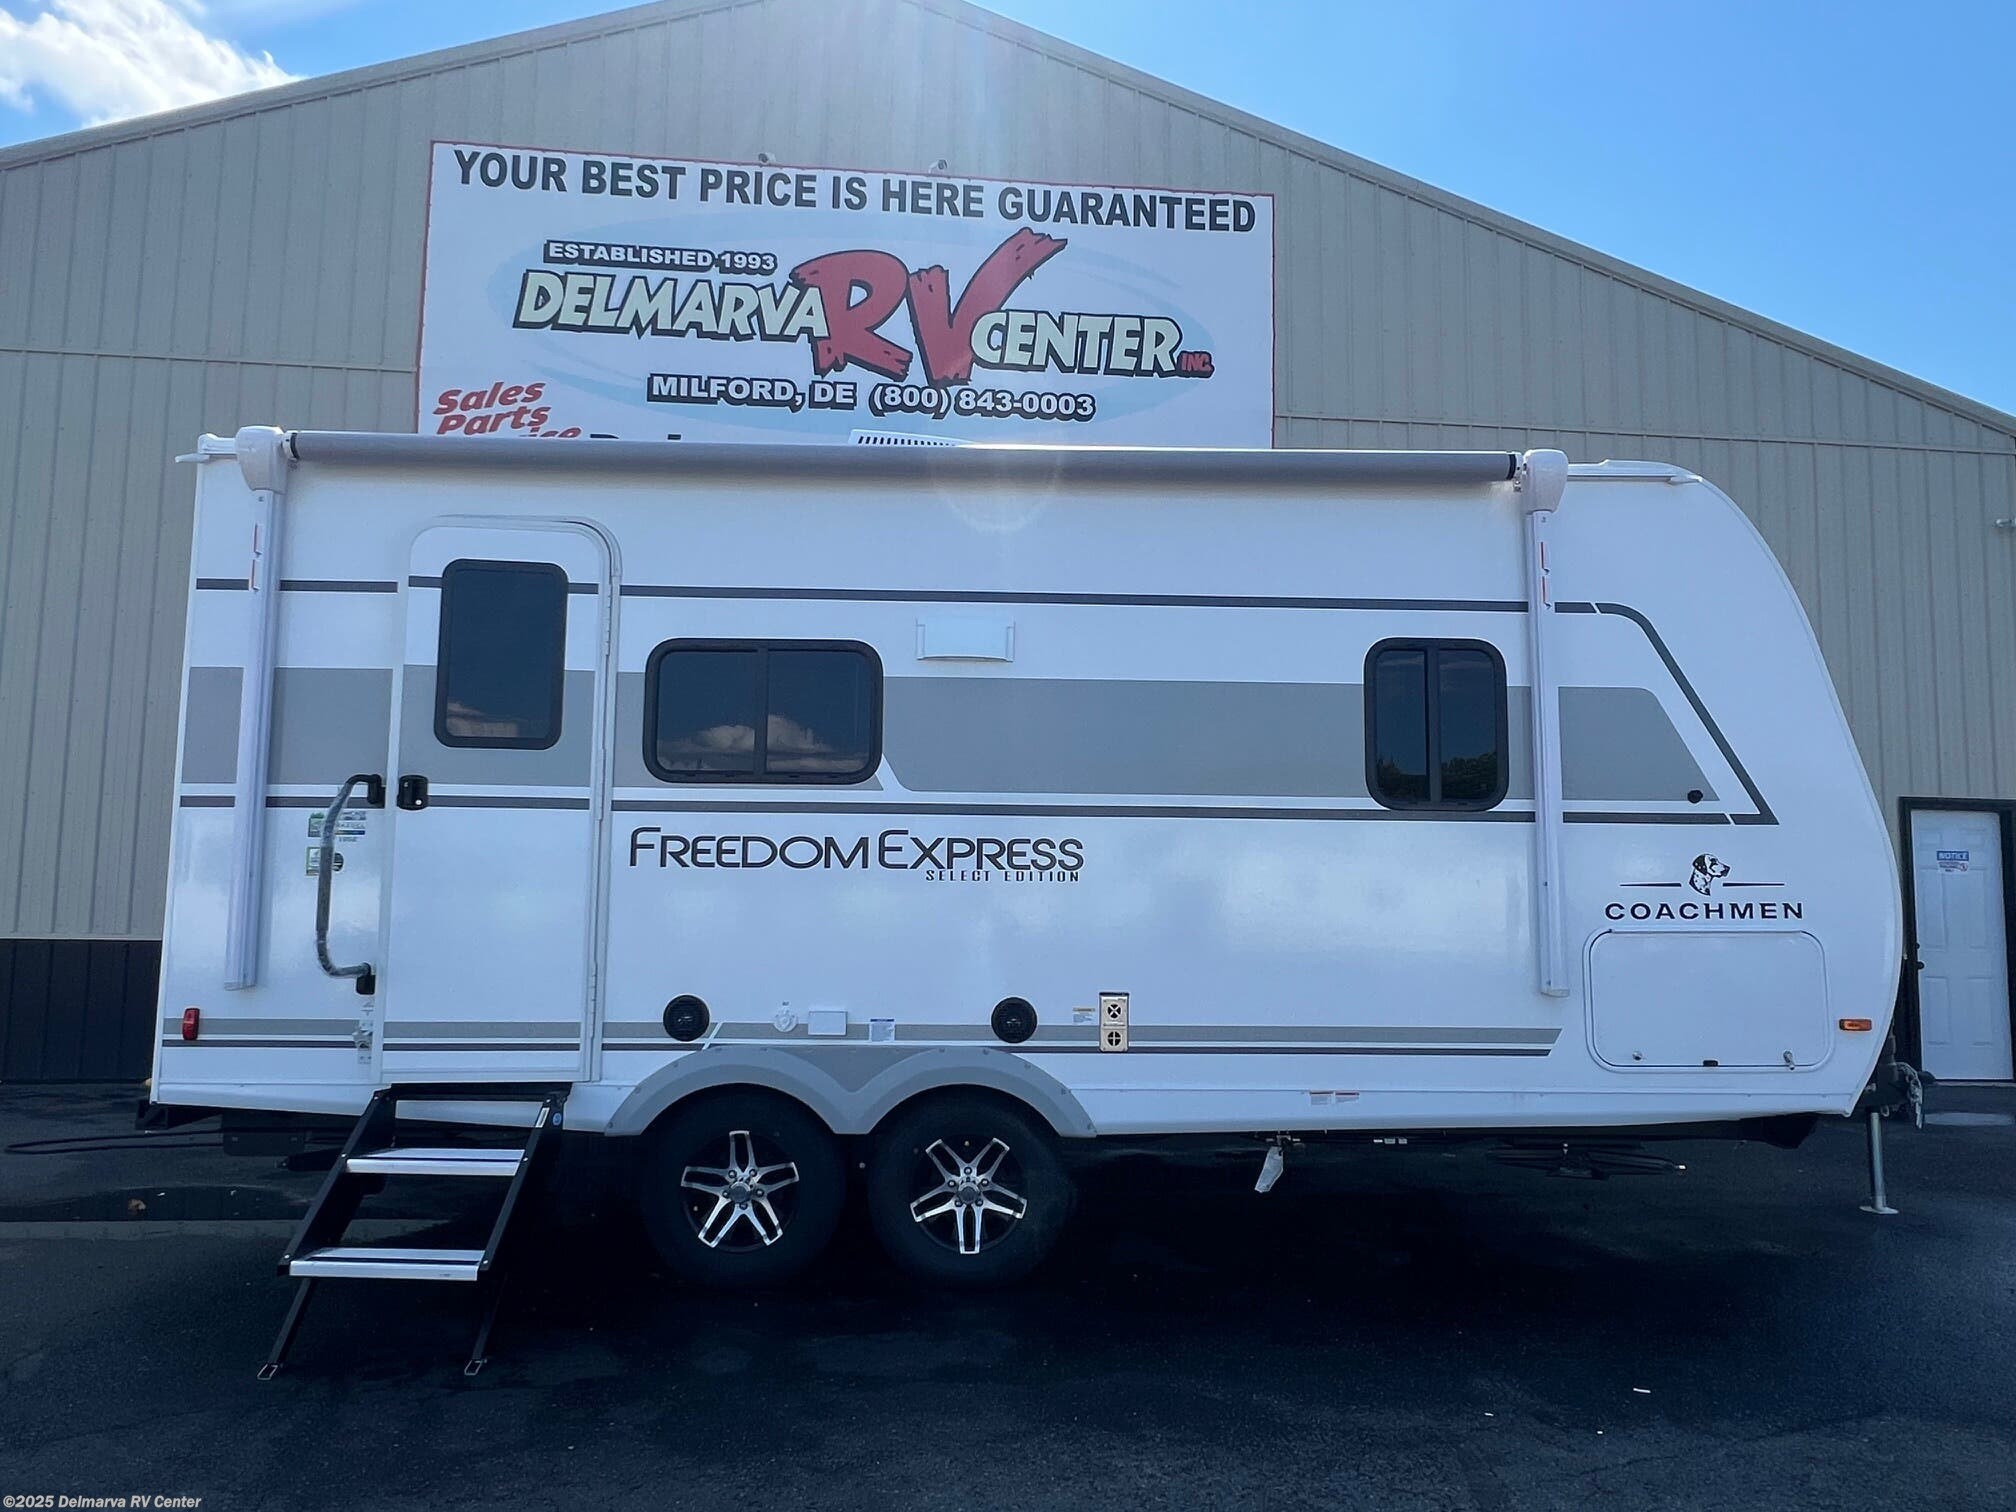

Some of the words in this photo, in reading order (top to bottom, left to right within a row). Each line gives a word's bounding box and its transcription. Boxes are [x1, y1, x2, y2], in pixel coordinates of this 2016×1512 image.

[453, 149, 567, 192] YOUR
[581, 159, 686, 200] BEST
[699, 168, 817, 208] PRICE
[831, 175, 868, 211] IS
[882, 178, 985, 218] HERE
[998, 186, 1256, 232] GUARANTEED
[546, 241, 715, 269] ESTABLISHED
[719, 251, 777, 272] 1993
[513, 269, 831, 341] DELMARVA
[789, 227, 1068, 387] RV
[970, 309, 1182, 378] CENTER
[432, 382, 546, 415] Sales
[651, 375, 806, 413] MILFORD,
[813, 382, 857, 408] DE
[872, 385, 949, 418] (800)
[958, 388, 1096, 418] 843-0003
[436, 406, 552, 436] Parts
[629, 826, 869, 869] FREEDOM
[879, 829, 1085, 871] EXPRESS
[925, 869, 991, 882] SELECT
[1004, 870, 1080, 883] EDITION
[1604, 902, 1804, 920] COACHMEN
